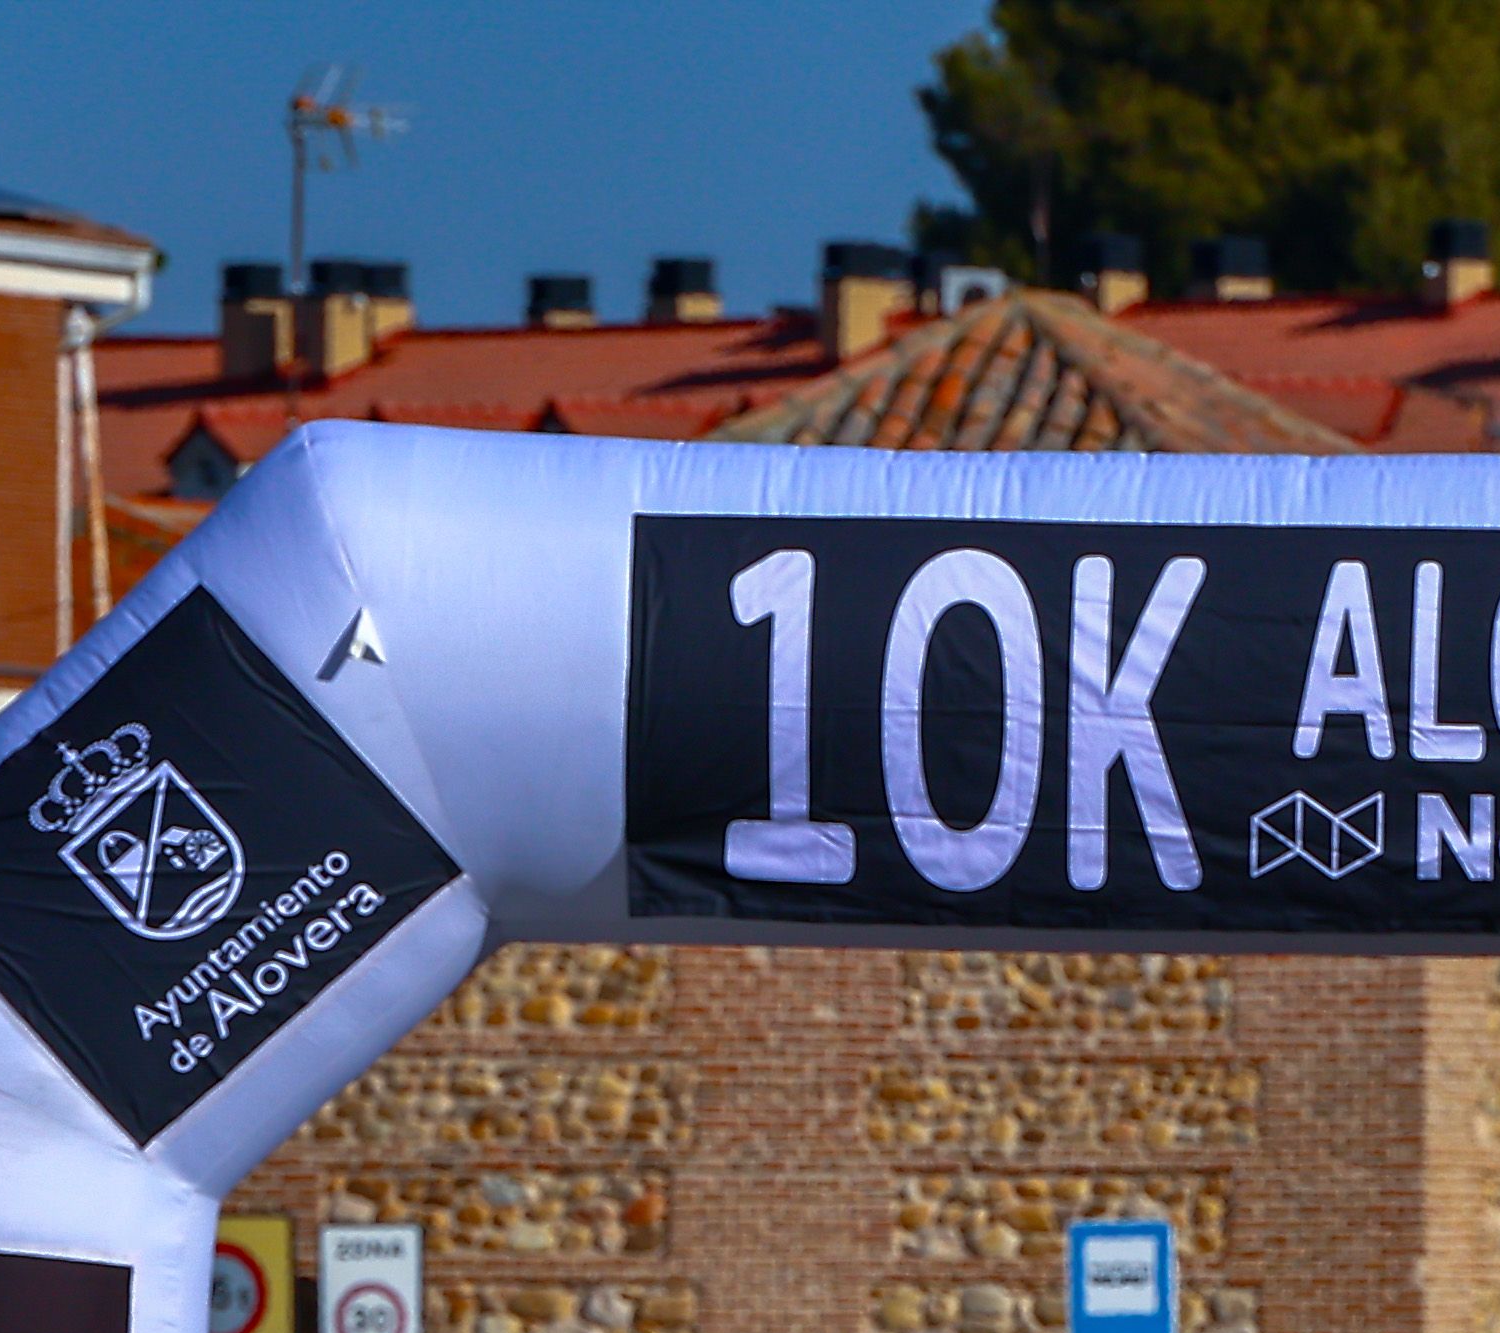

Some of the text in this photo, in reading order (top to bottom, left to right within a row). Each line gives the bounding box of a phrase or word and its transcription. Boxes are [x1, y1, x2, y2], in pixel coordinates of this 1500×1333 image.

[724, 547, 1207, 892] 10K
[133, 849, 351, 1040] Ayuntamiento
[168, 878, 386, 1075] de Alovera
[353, 1304, 393, 1333] 30
